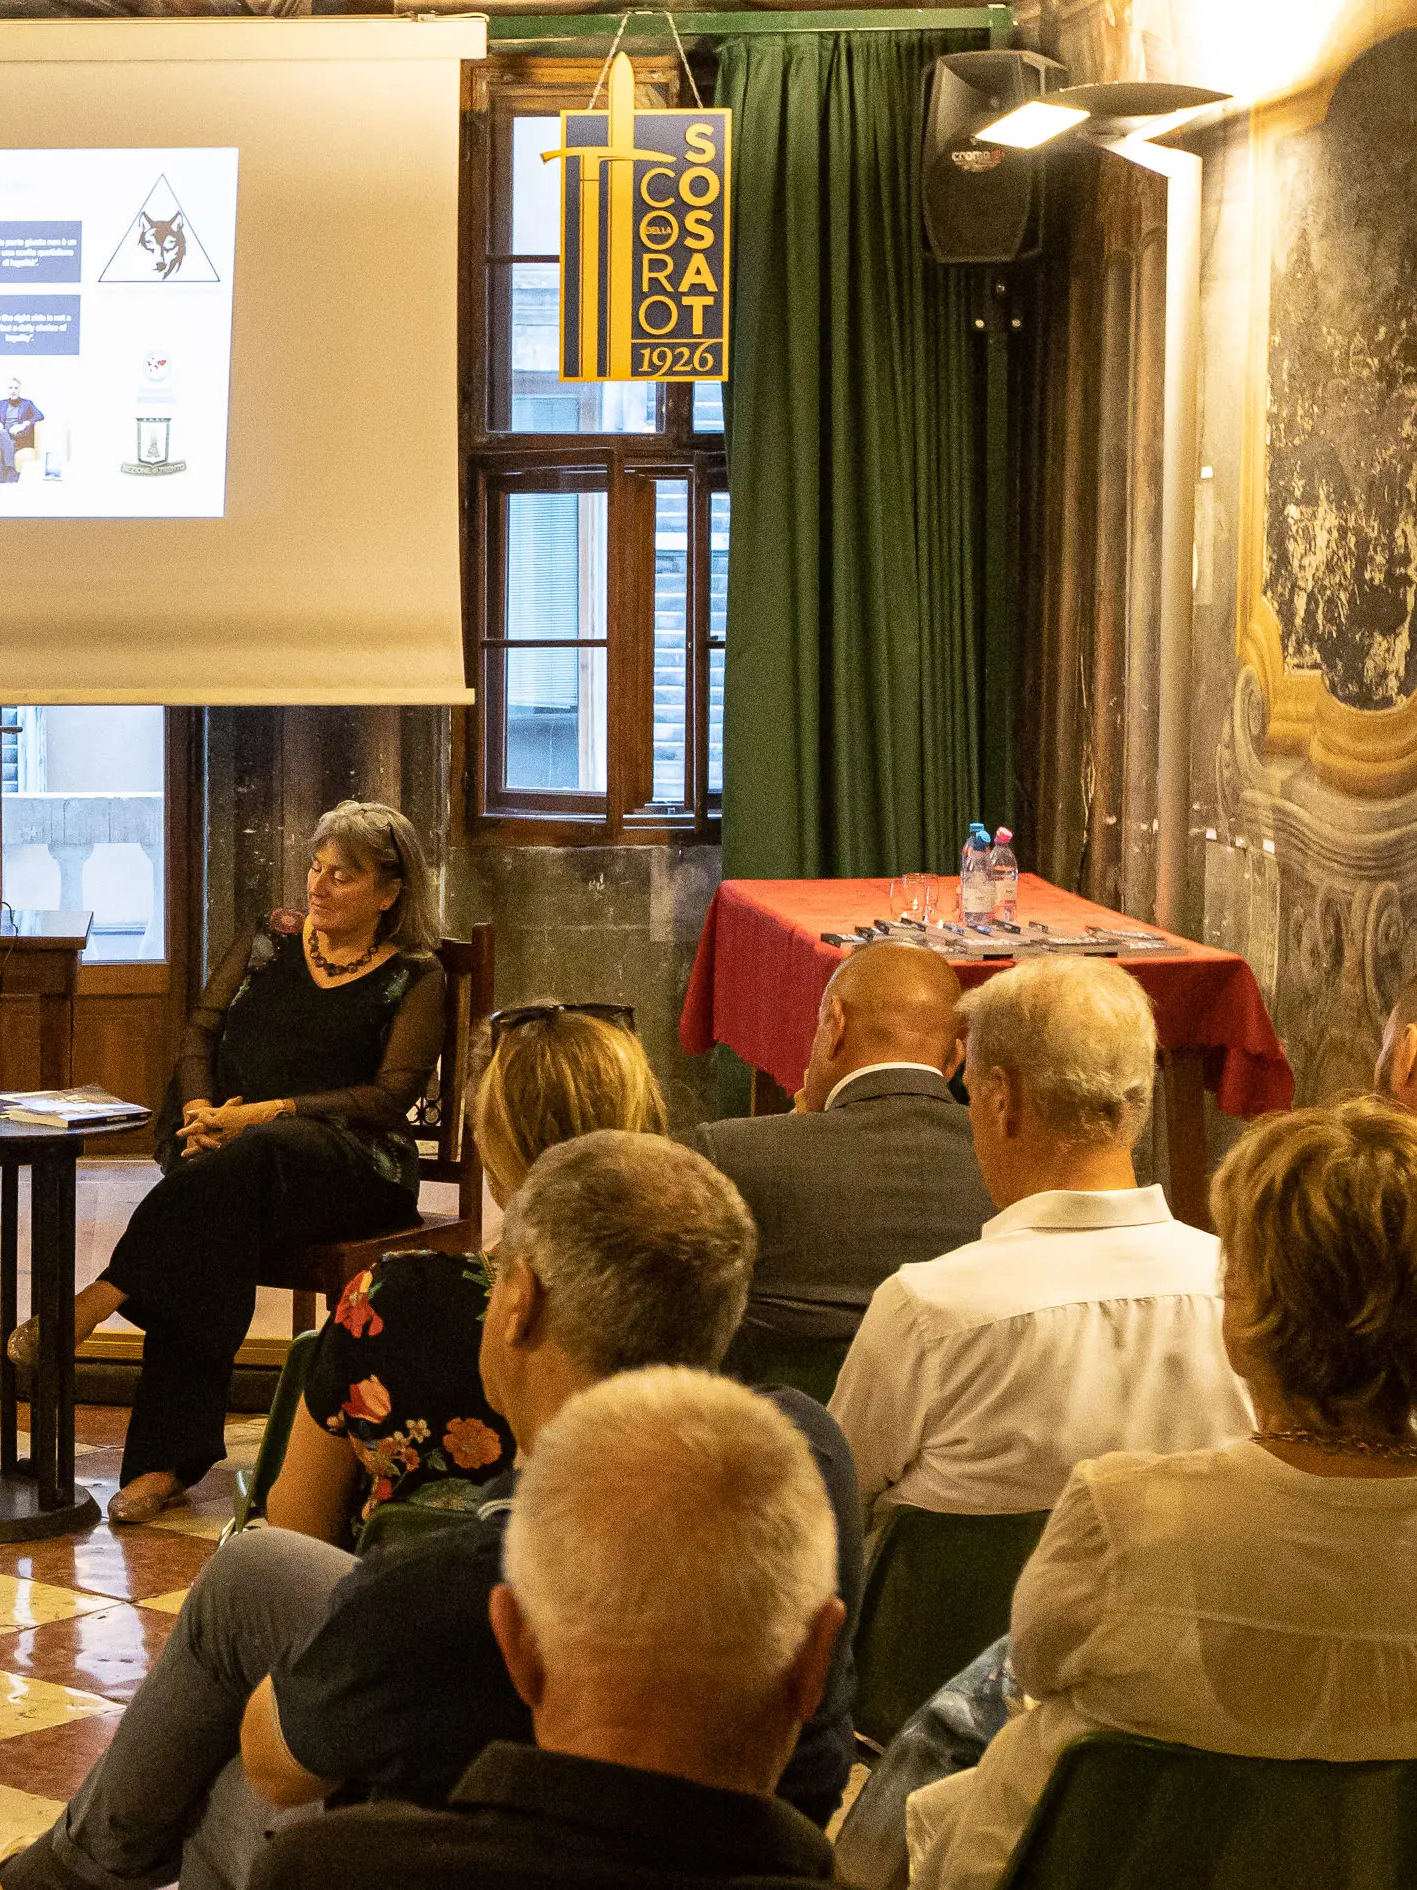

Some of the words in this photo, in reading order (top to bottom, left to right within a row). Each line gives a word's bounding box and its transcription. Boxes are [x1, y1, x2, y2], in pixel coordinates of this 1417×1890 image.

[638, 166, 680, 336] CORO
[677, 121, 721, 336] SOSAT
[638, 342, 715, 377] 1926
